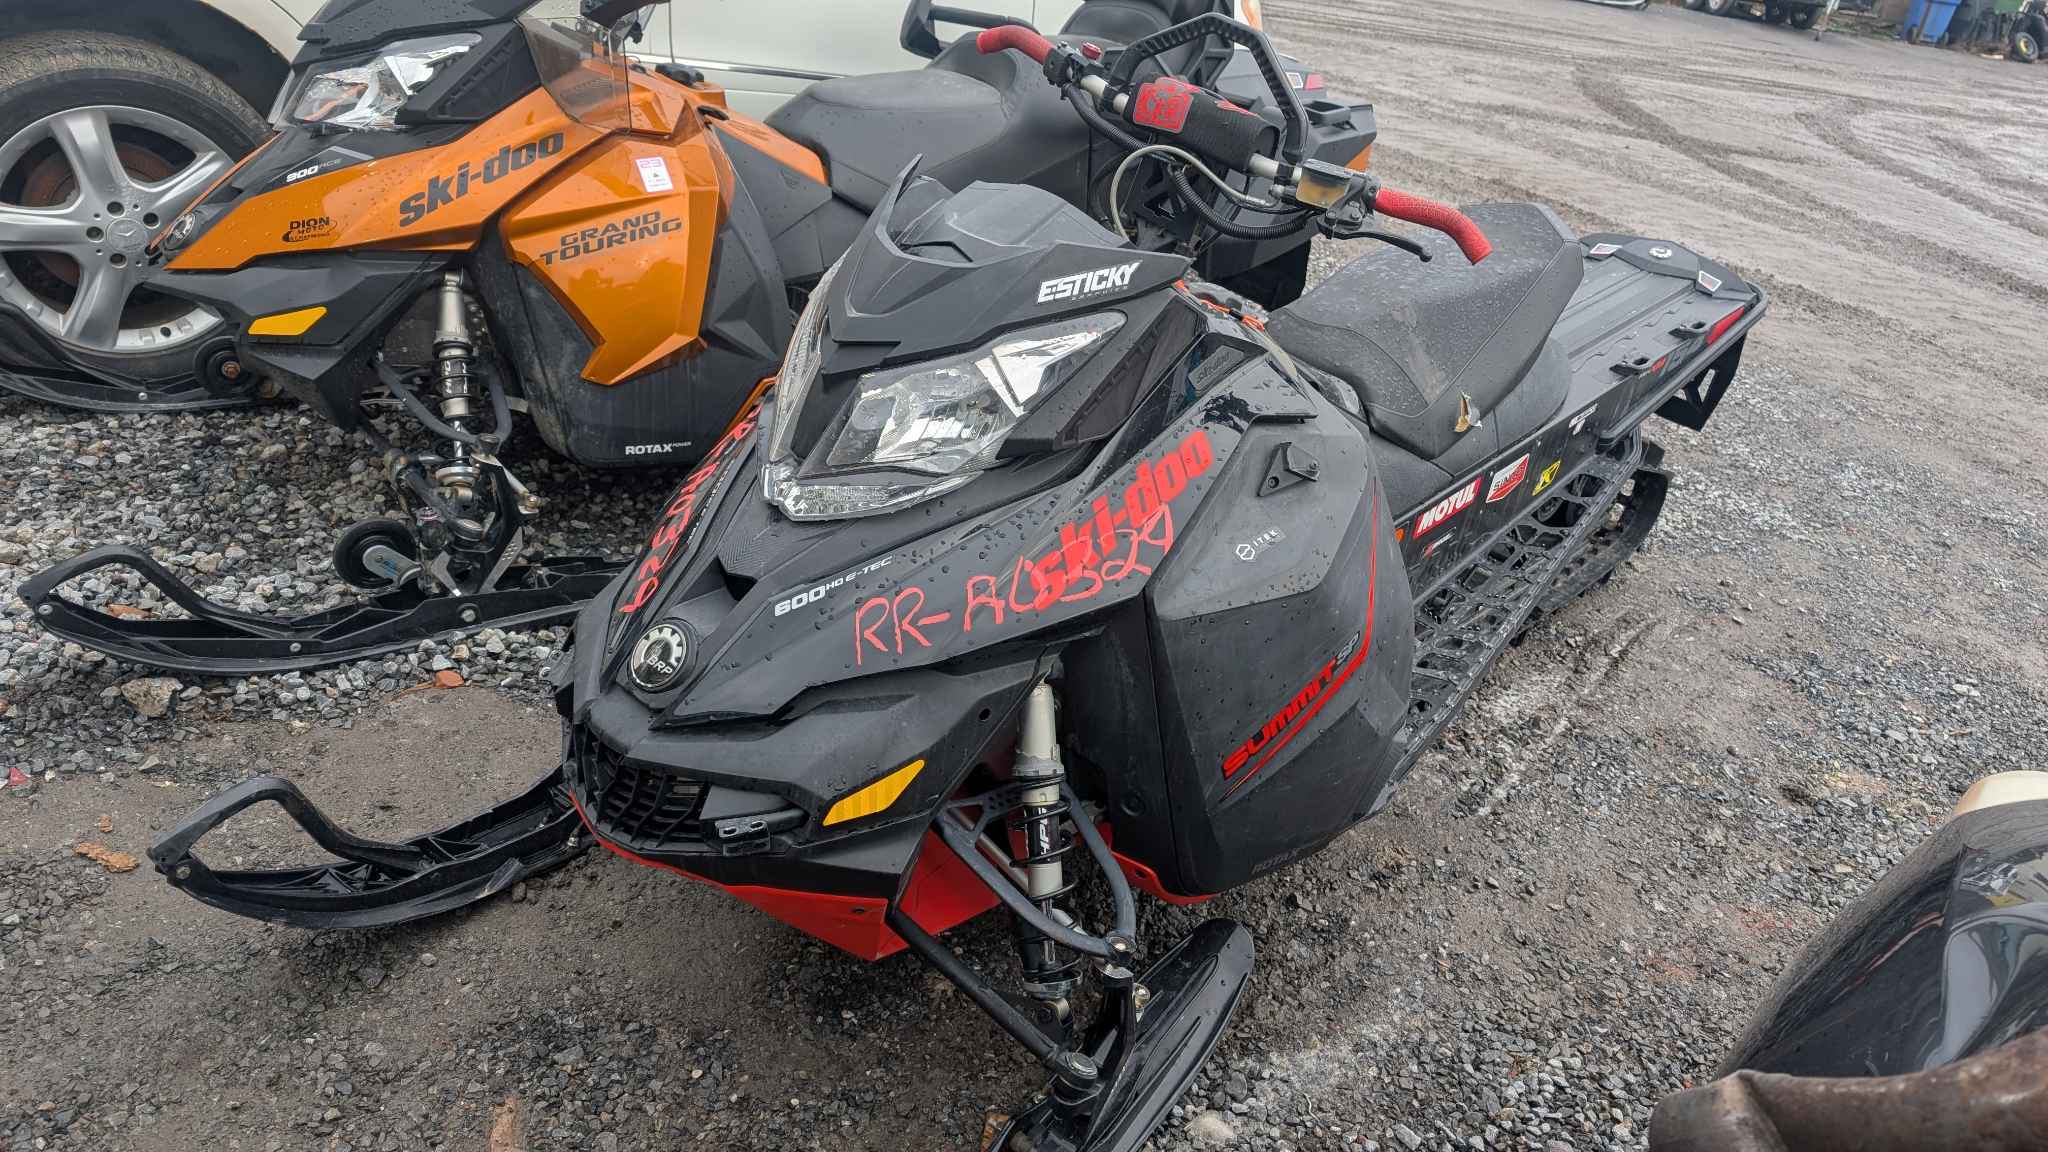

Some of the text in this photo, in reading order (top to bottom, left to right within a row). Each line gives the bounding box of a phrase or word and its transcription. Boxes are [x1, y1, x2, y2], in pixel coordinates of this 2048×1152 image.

[286, 165, 319, 183] 900
[400, 132, 565, 228] ski-doo
[289, 216, 330, 230] DION
[540, 217, 683, 265] TOURING
[560, 211, 661, 247] GRAND
[624, 443, 673, 456] ROTAX
[1030, 431, 1214, 613] ski-doo
[1417, 478, 1478, 535] MOTUL
[845, 555, 893, 582] E-TEC
[647, 654, 673, 674] BRP
[1222, 656, 1337, 780] SUMMIT
